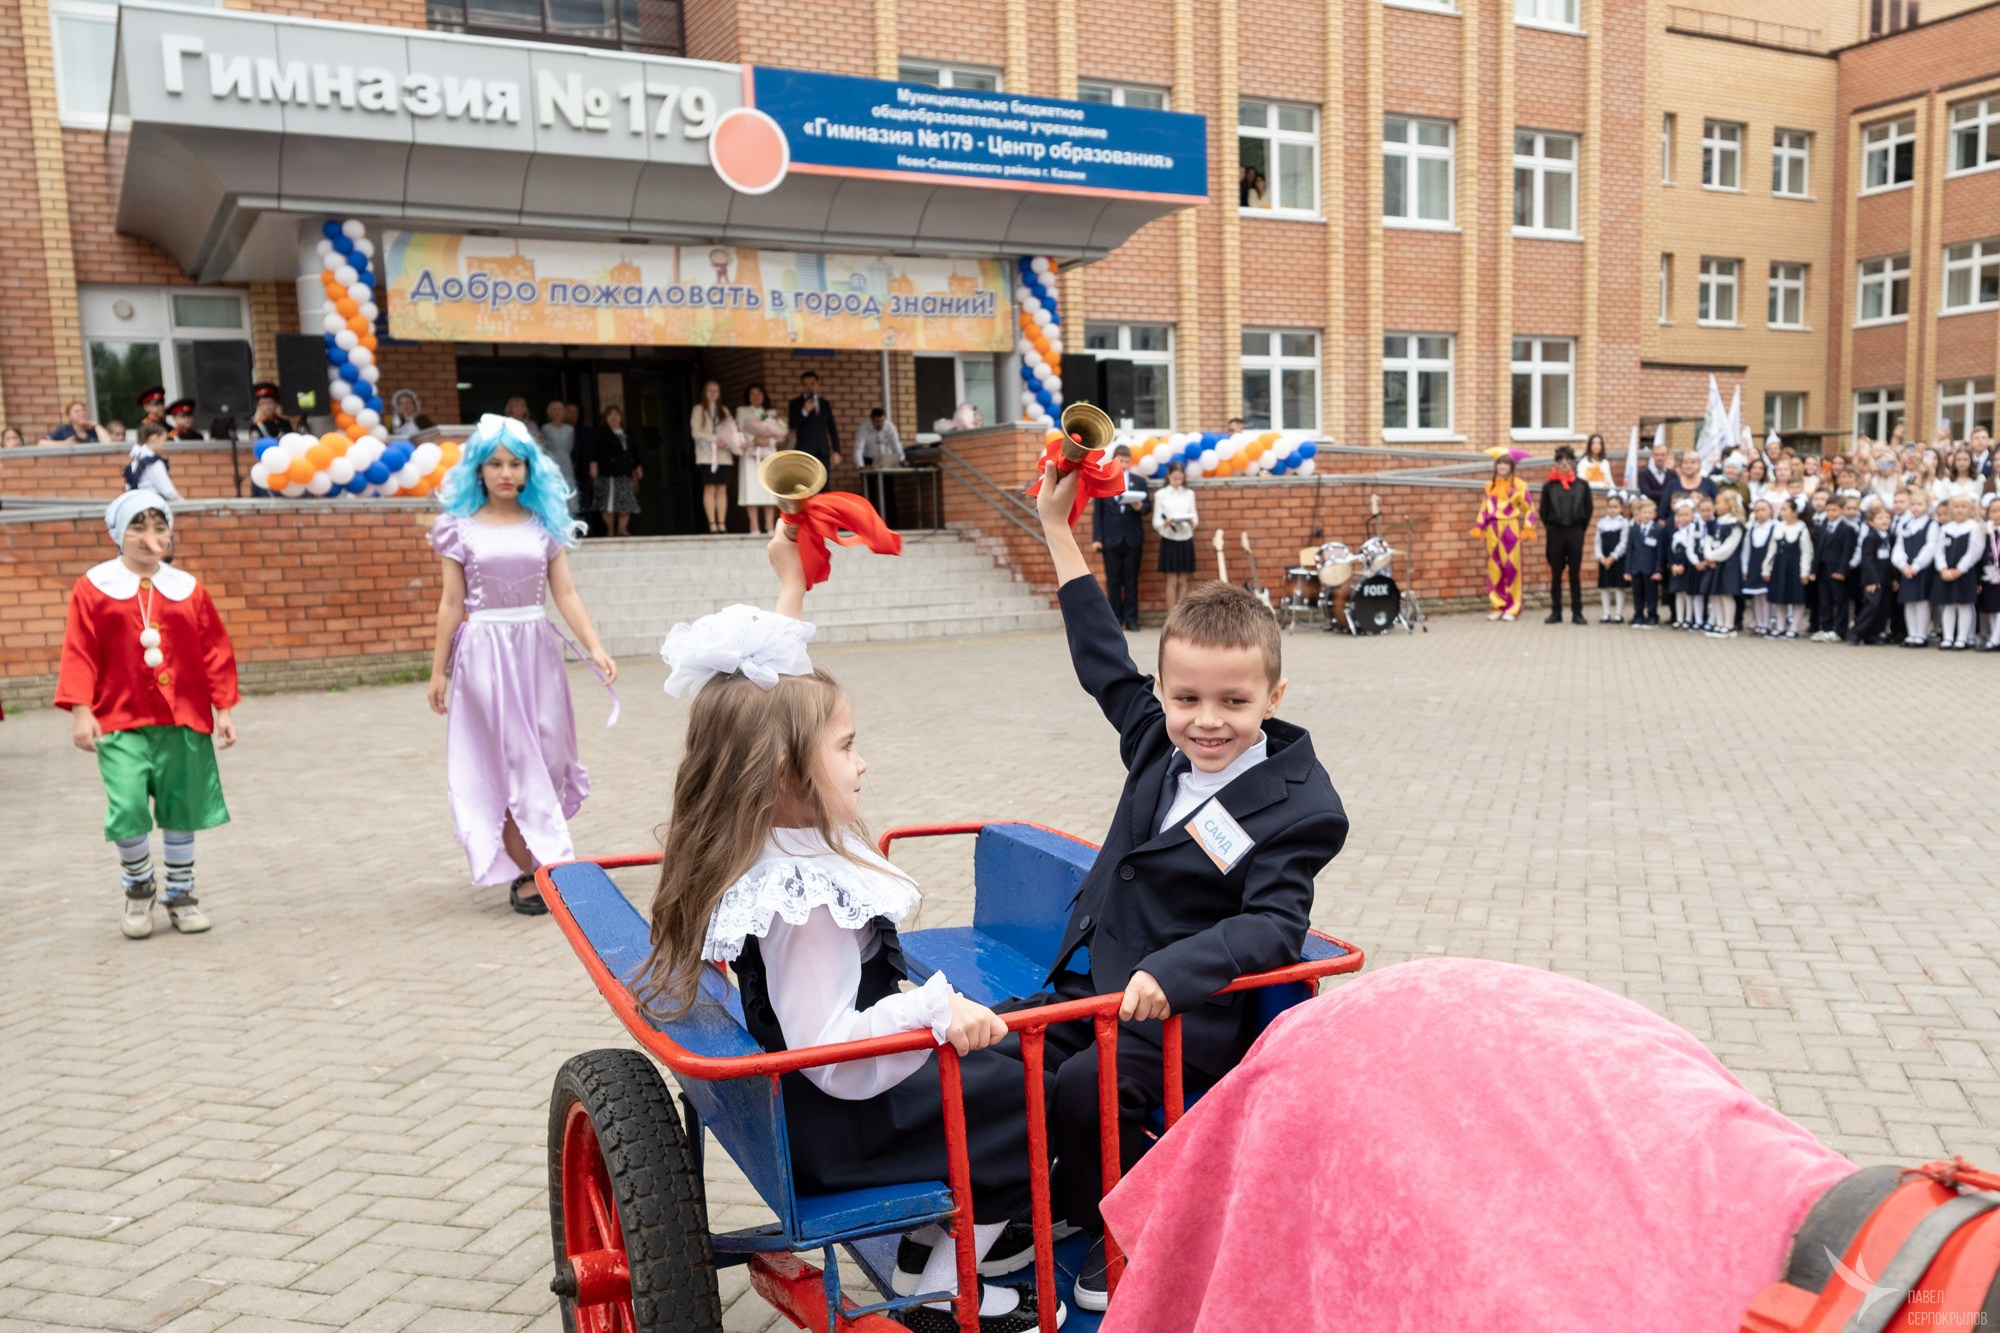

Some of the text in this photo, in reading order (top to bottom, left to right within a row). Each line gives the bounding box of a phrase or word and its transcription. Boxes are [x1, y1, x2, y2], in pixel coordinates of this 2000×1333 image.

[160, 33, 522, 123] Гимназия
[871, 104, 1108, 140] общеобразовательное учреждение
[897, 88, 1085, 122] Муниципальное бюджетное
[803, 117, 914, 147] «Гимназия
[917, 128, 973, 151] №179
[988, 135, 1046, 162] Центр
[1049, 142, 1174, 170] образования»
[897, 155, 1003, 174] Ново-Савиновского
[1004, 164, 1040, 178] района
[1051, 168, 1087, 180] Казани
[410, 269, 997, 319] Добро пожаловать в город знаний!
[1204, 820, 1233, 855] САИД
